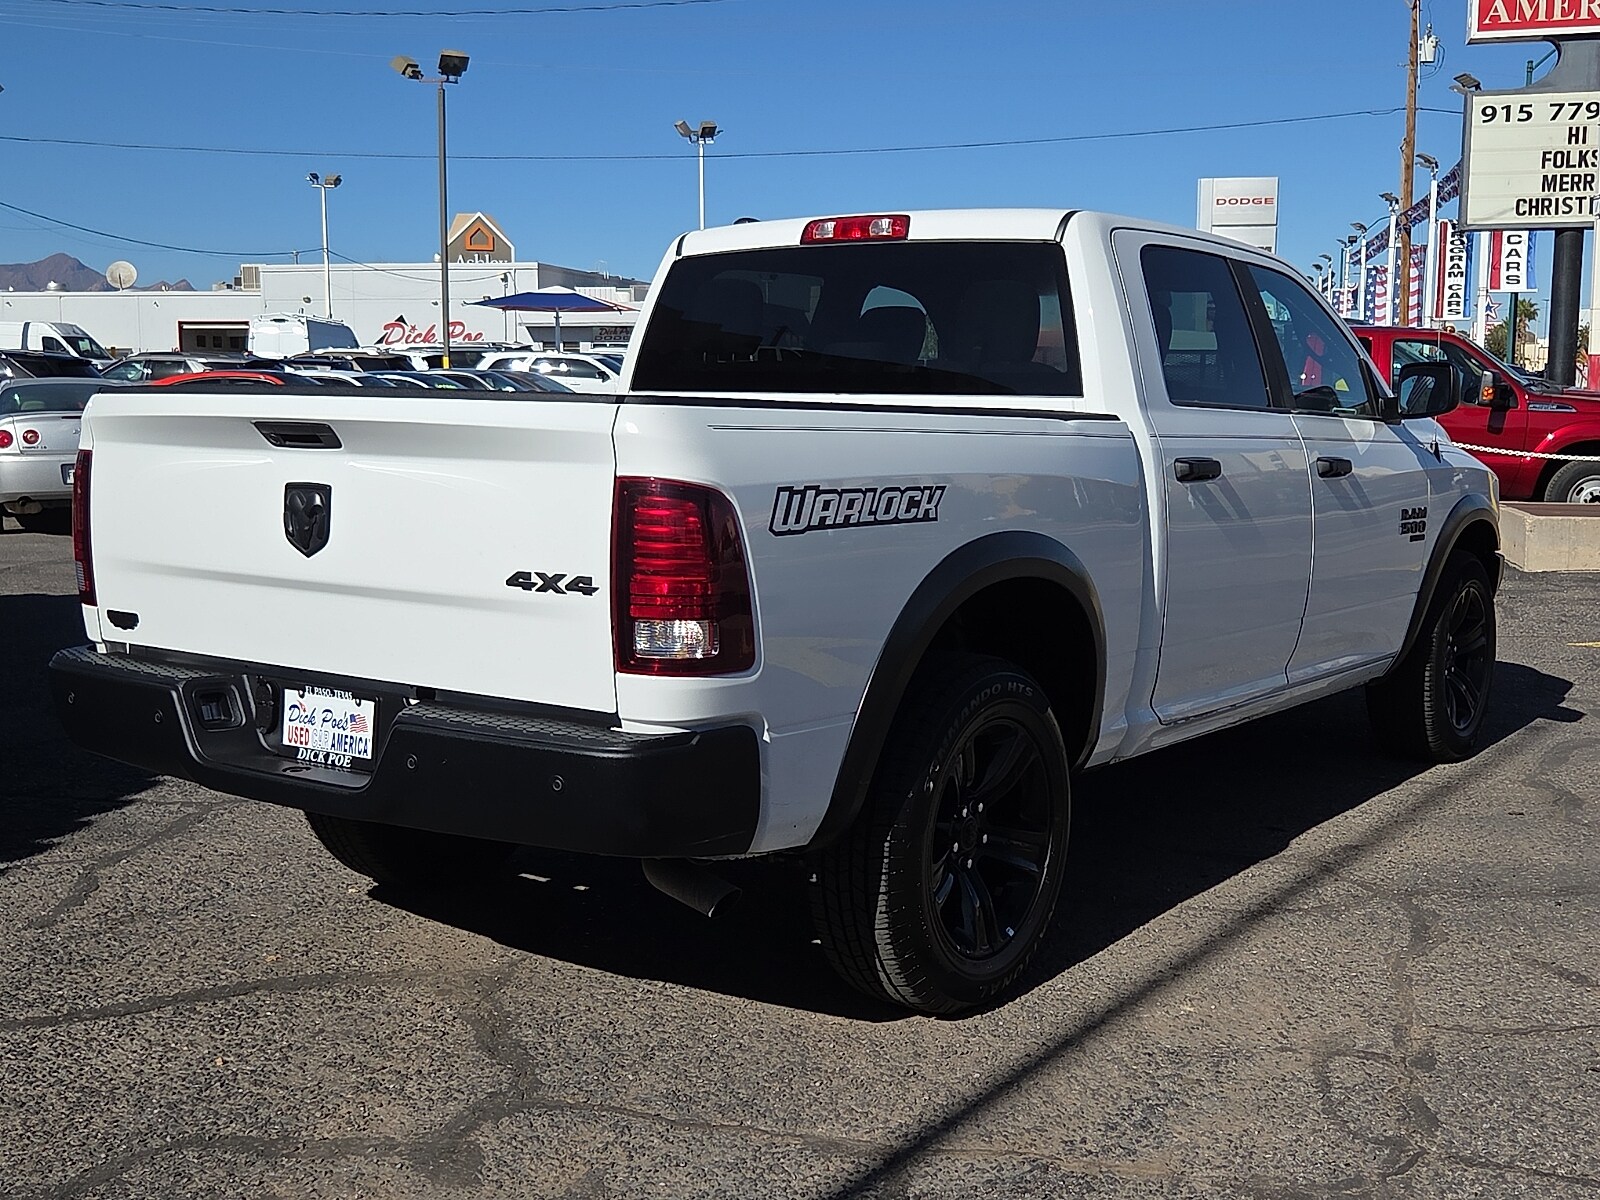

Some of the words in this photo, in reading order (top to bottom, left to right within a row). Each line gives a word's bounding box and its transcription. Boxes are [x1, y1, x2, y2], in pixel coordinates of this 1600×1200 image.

[1481, 104, 1533, 124] 915
[1549, 101, 1600, 122] 779
[1567, 126, 1588, 145] HI
[1541, 149, 1598, 170] FOLKS
[1216, 197, 1275, 206] DODGE
[1505, 234, 1523, 285] CARS
[1447, 284, 1463, 316] CARS
[383, 322, 438, 345] Dick
[449, 321, 484, 341] Poe
[1400, 506, 1427, 521] RAM
[305, 685, 314, 695] EL
[333, 690, 353, 700] TEXAS
[1007, 681, 1034, 697] HTS
[289, 704, 316, 726] Dick
[321, 709, 349, 731] Poe's
[288, 725, 310, 746] USED
[330, 732, 369, 756] AMERICA
[297, 748, 327, 763] DICK
[328, 753, 353, 767] POE
